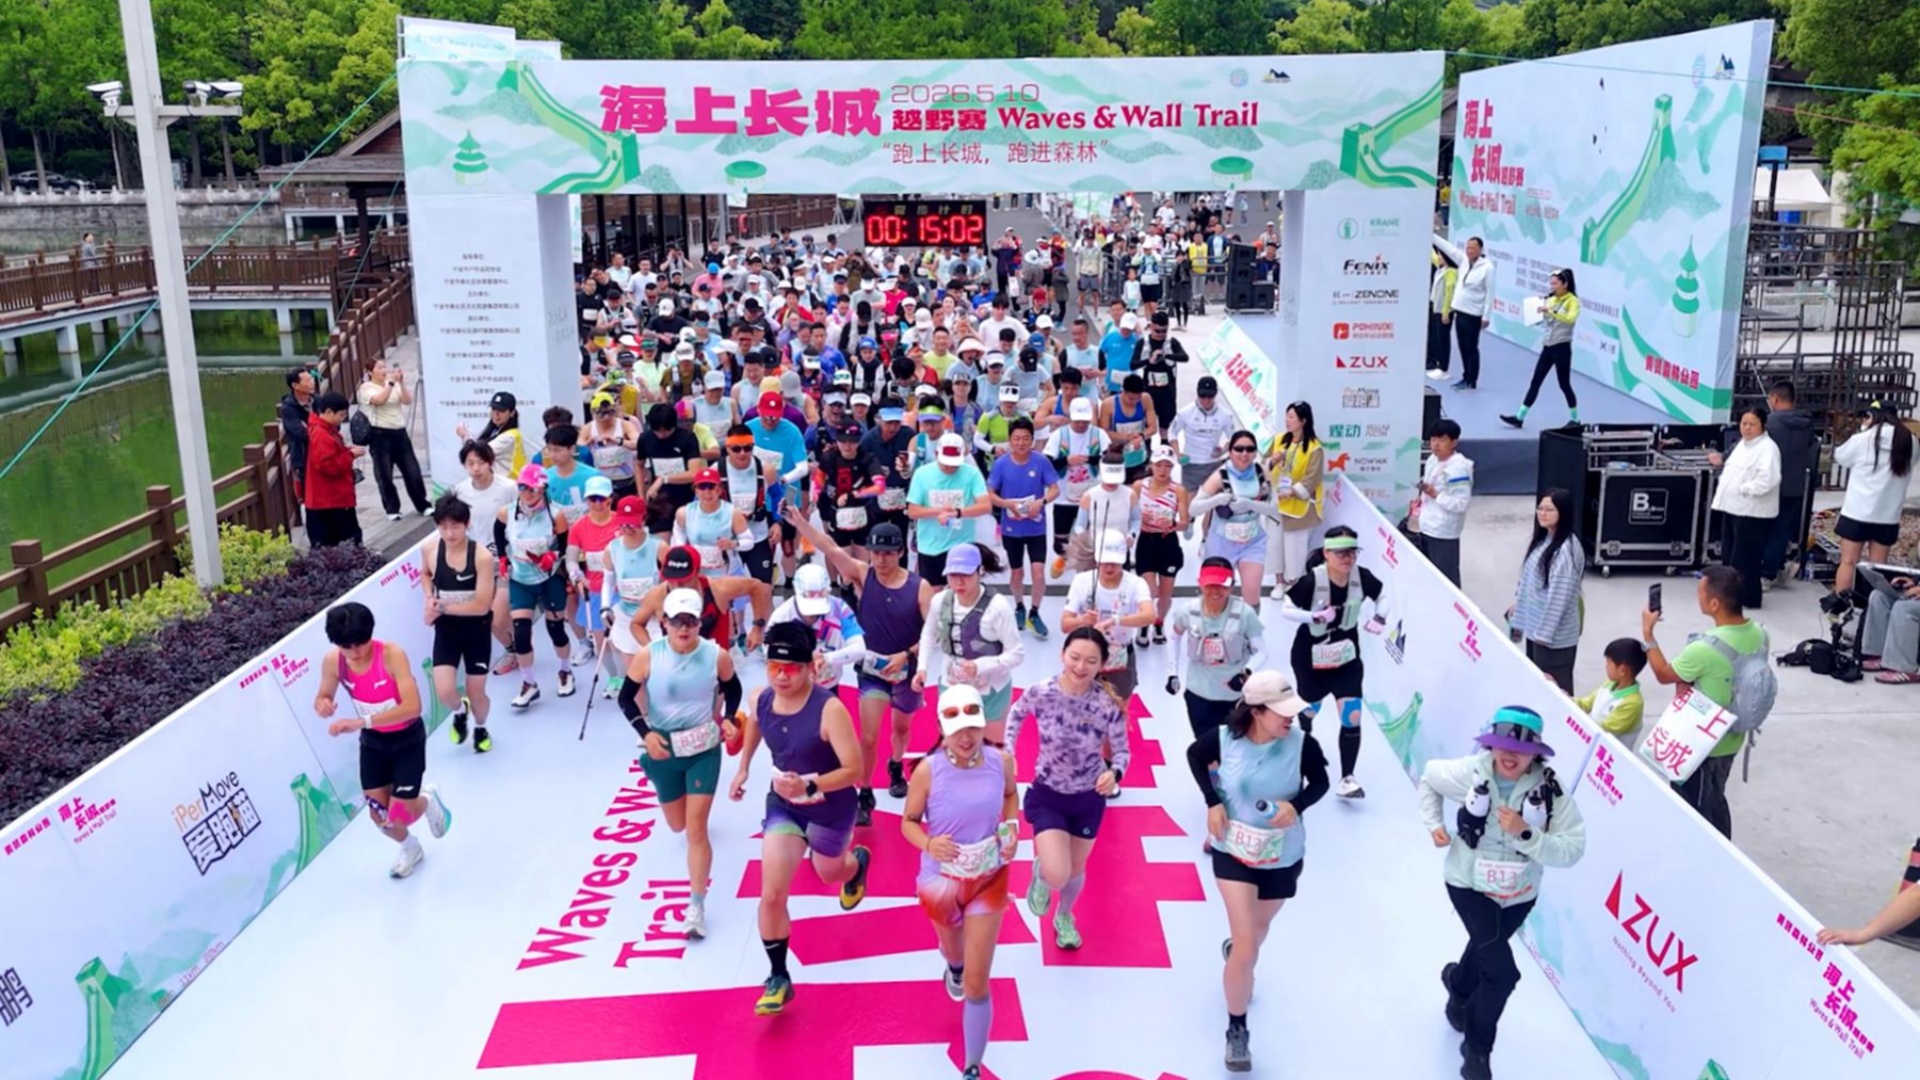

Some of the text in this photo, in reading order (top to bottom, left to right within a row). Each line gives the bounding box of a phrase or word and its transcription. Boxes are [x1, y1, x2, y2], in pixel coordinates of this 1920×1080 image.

[599, 84, 881, 137] 海上长城
[891, 84, 1039, 103] 2026.5.10
[892, 101, 1259, 131] 越野赛 Waves & Wall Trail
[867, 215, 983, 244] 00:15:02
[1349, 355, 1389, 369] ZUX
[171, 770, 240, 833] iPerMove
[515, 852, 638, 971] Waves
[592, 818, 656, 844] &
[612, 879, 710, 968] Trail
[1620, 891, 1699, 995] ZUX
[1822, 961, 1856, 1003] 海上
